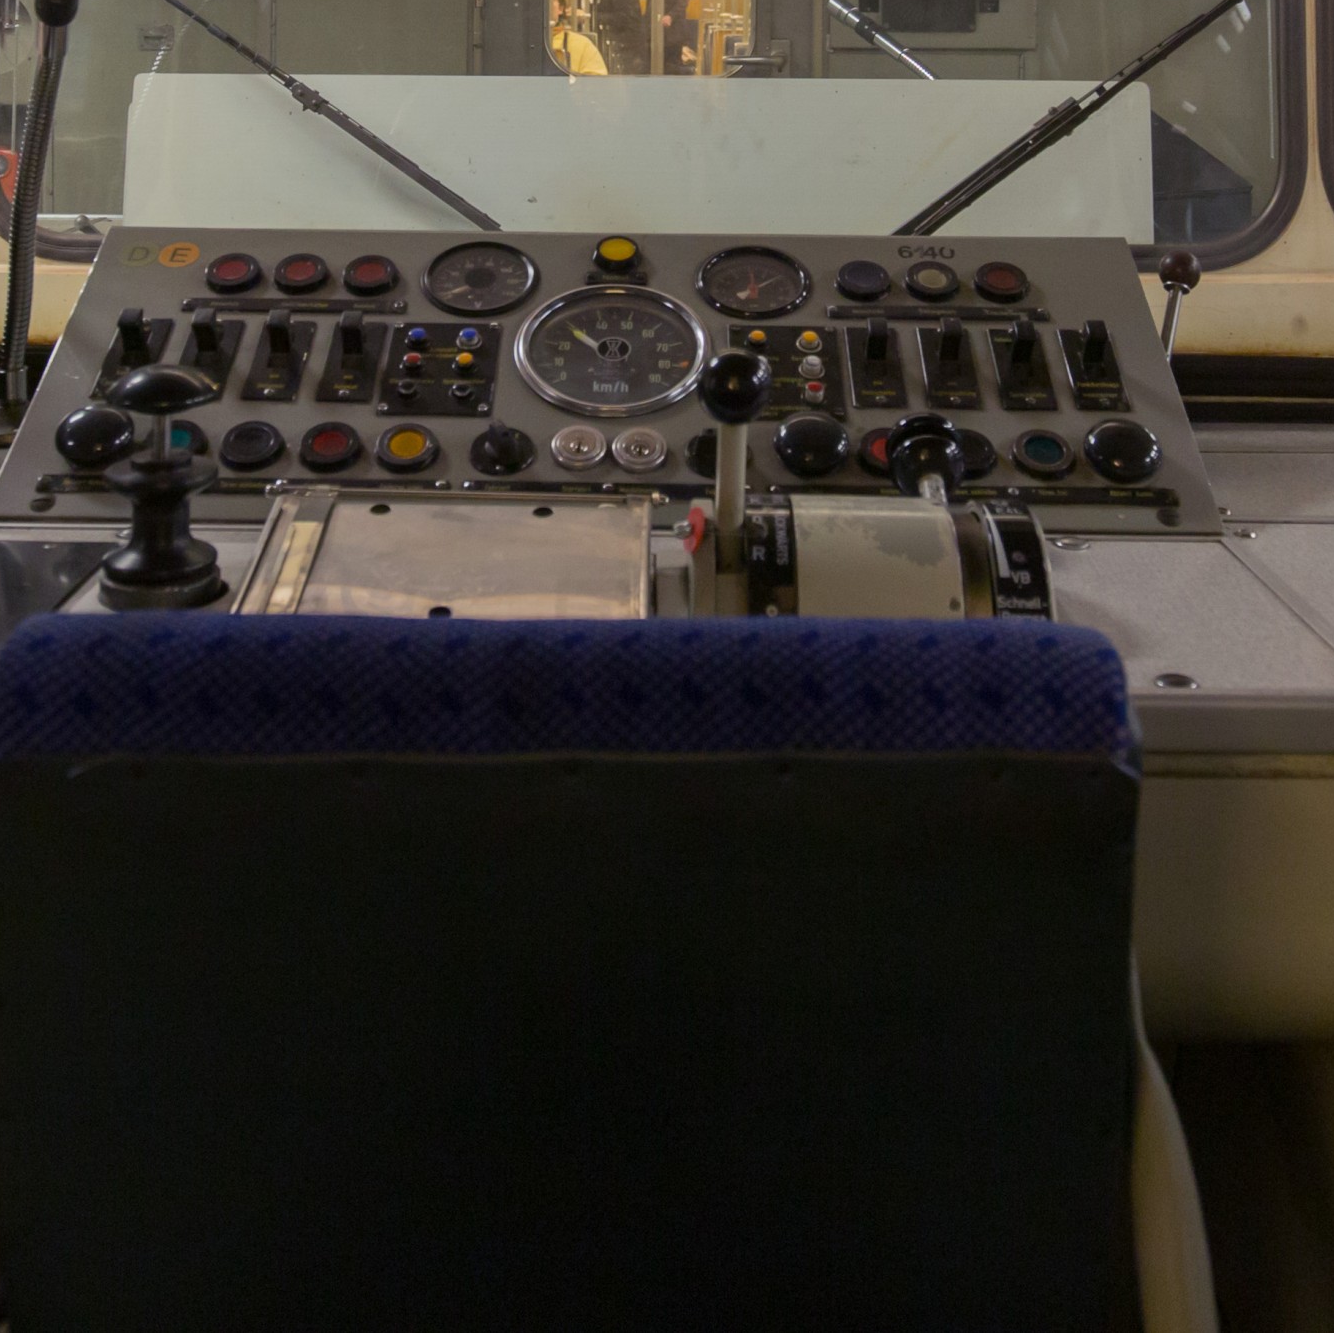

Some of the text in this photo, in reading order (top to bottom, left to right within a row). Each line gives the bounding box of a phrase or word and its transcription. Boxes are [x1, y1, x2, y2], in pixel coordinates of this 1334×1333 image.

[169, 247, 192, 263] E
[898, 245, 955, 259] 6140
[593, 380, 629, 393] km/h
[1011, 571, 1031, 585] VB
